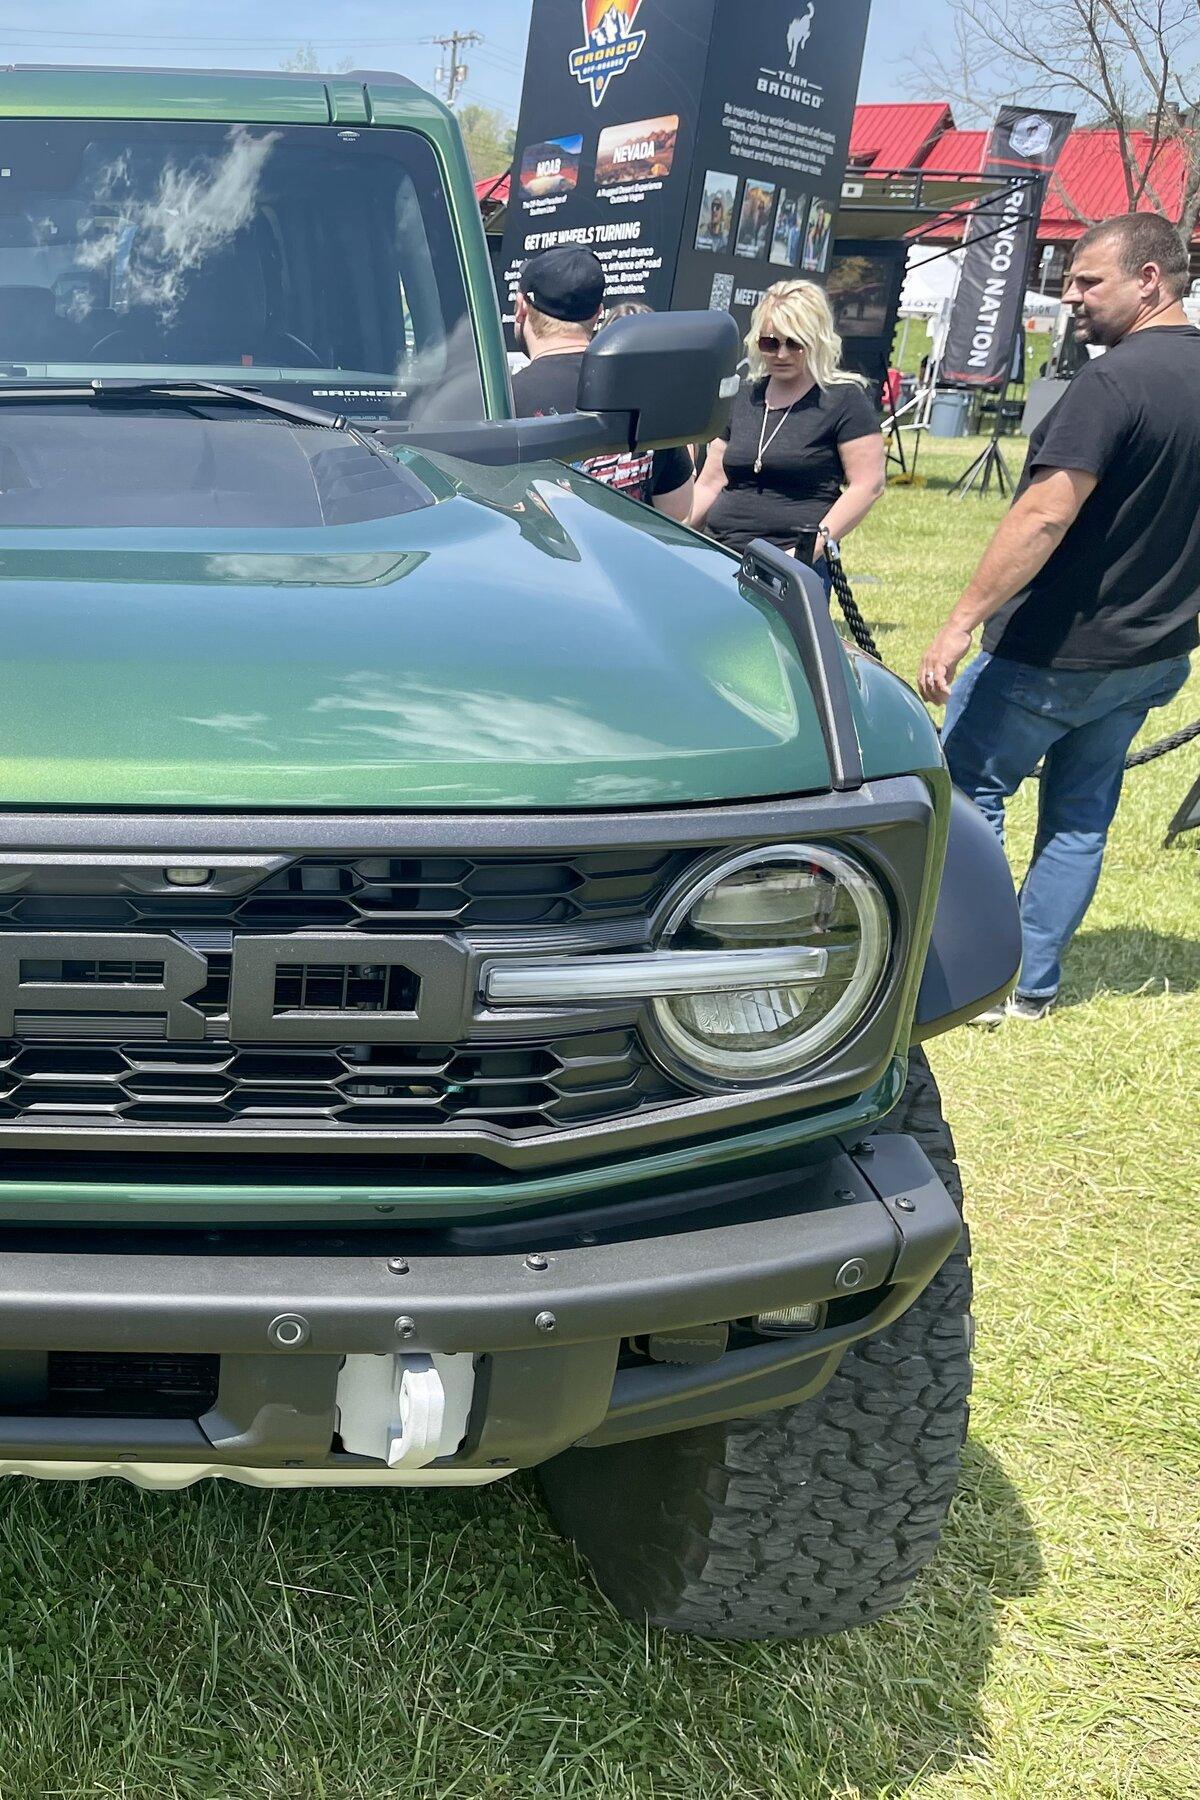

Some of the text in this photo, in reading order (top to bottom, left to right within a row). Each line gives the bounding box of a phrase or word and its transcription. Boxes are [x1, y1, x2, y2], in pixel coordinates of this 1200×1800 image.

[574, 40, 638, 67] BRONCO
[778, 70, 808, 88] TEAM
[612, 141, 655, 163] NEVADA
[535, 158, 561, 177] MOAB
[524, 233, 541, 250] GET
[594, 221, 641, 242] TURNING
[967, 278, 1006, 367] NATION
